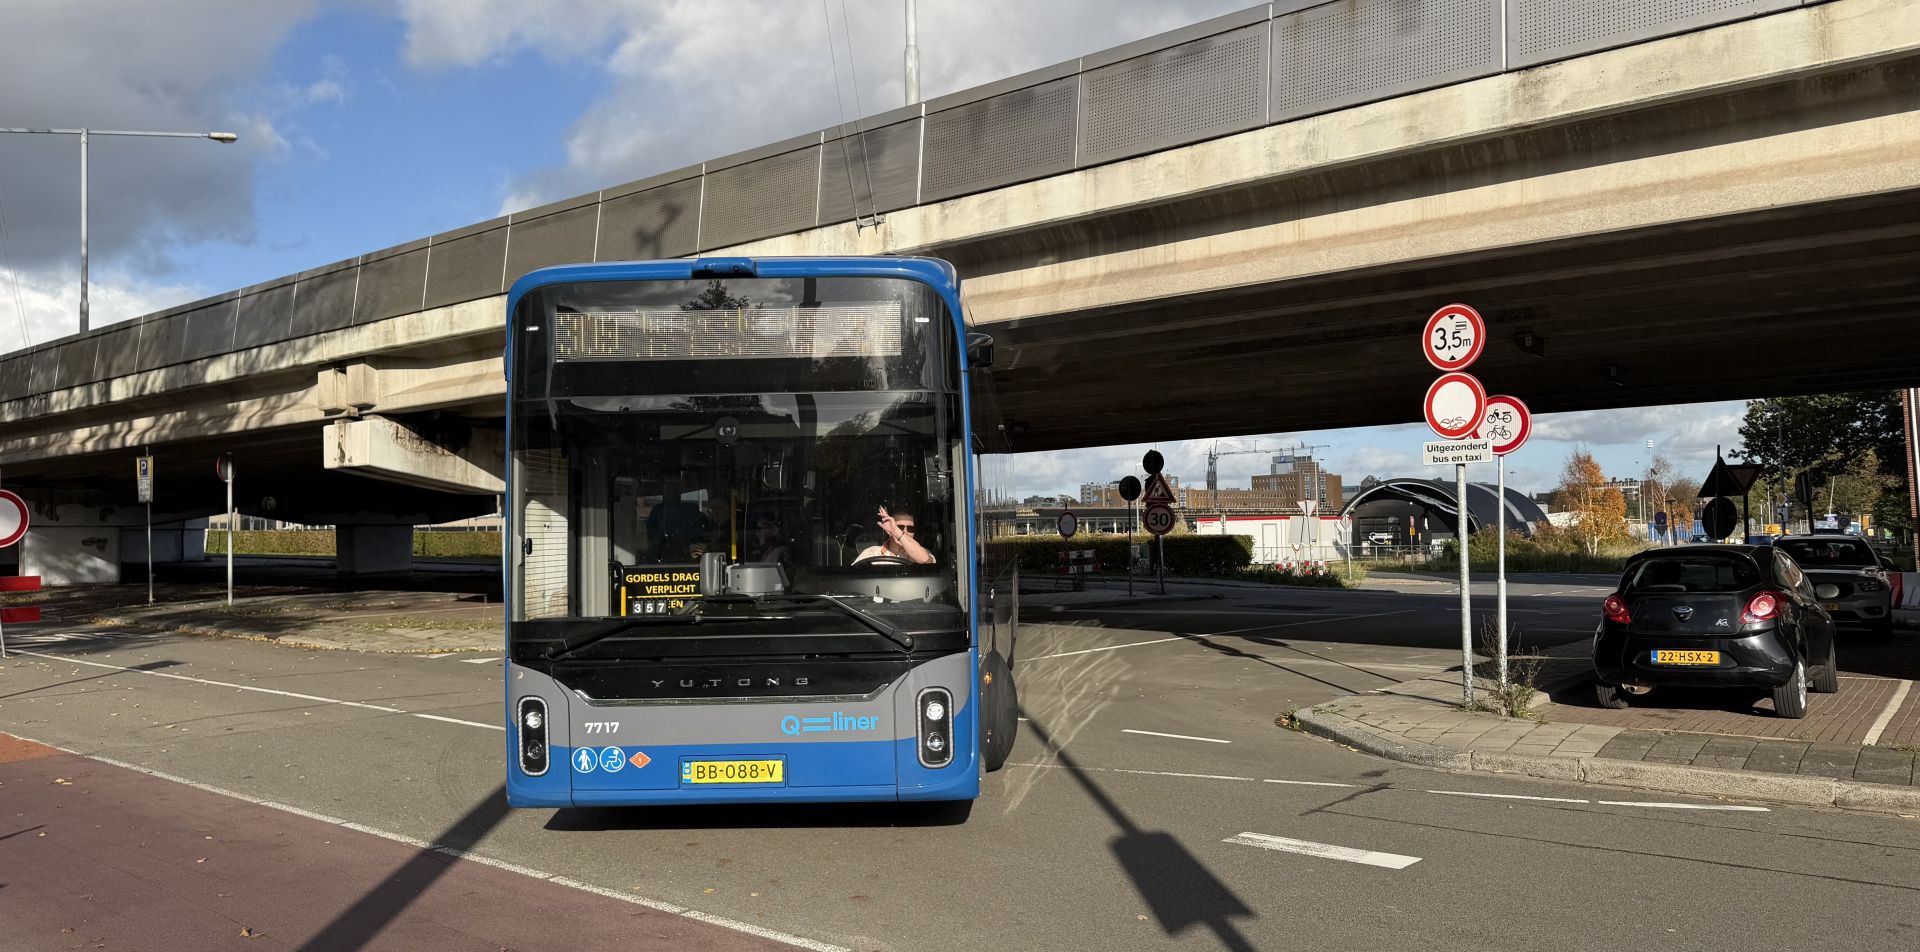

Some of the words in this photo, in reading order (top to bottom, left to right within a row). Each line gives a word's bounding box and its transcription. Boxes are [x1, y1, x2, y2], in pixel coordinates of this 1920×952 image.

[1427, 442, 1488, 454] Uitgezonderd
[1432, 455, 1449, 463] bus
[1452, 455, 1463, 463] en
[1465, 454, 1482, 462] taxi
[1150, 512, 1169, 527] 30
[625, 573, 670, 583] GORDELS
[672, 573, 700, 582] DRAG
[645, 584, 696, 594] VERPLICHT
[1660, 651, 1714, 663] 22-HSX-2
[651, 677, 809, 688] YUTONG
[584, 721, 620, 734] 7717
[696, 763, 776, 780] BB-088-V
